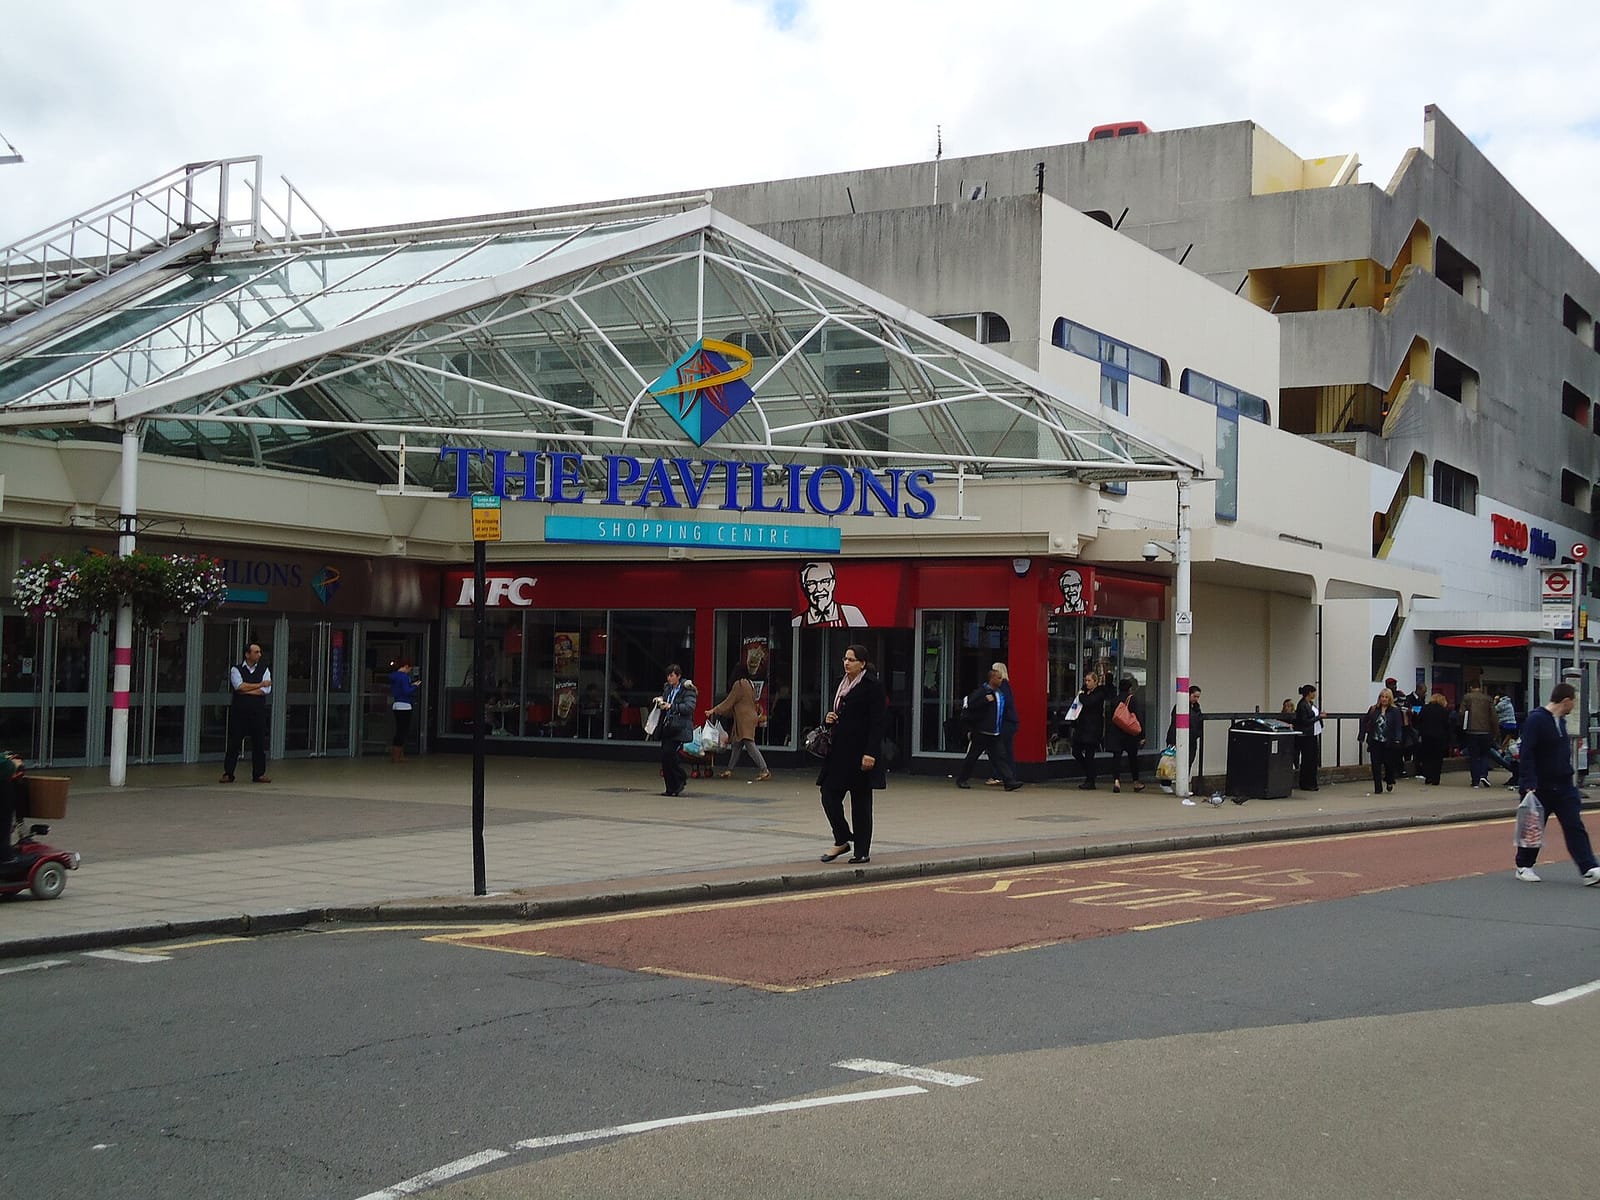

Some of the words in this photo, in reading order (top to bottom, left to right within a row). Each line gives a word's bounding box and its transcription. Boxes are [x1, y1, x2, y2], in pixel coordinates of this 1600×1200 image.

[440, 446, 585, 503] THE
[600, 453, 937, 519] PAVILIONS
[599, 521, 701, 541] SHOPPING
[718, 526, 790, 544] CENTRE
[1573, 544, 1584, 556] C
[456, 577, 538, 606] KFC
